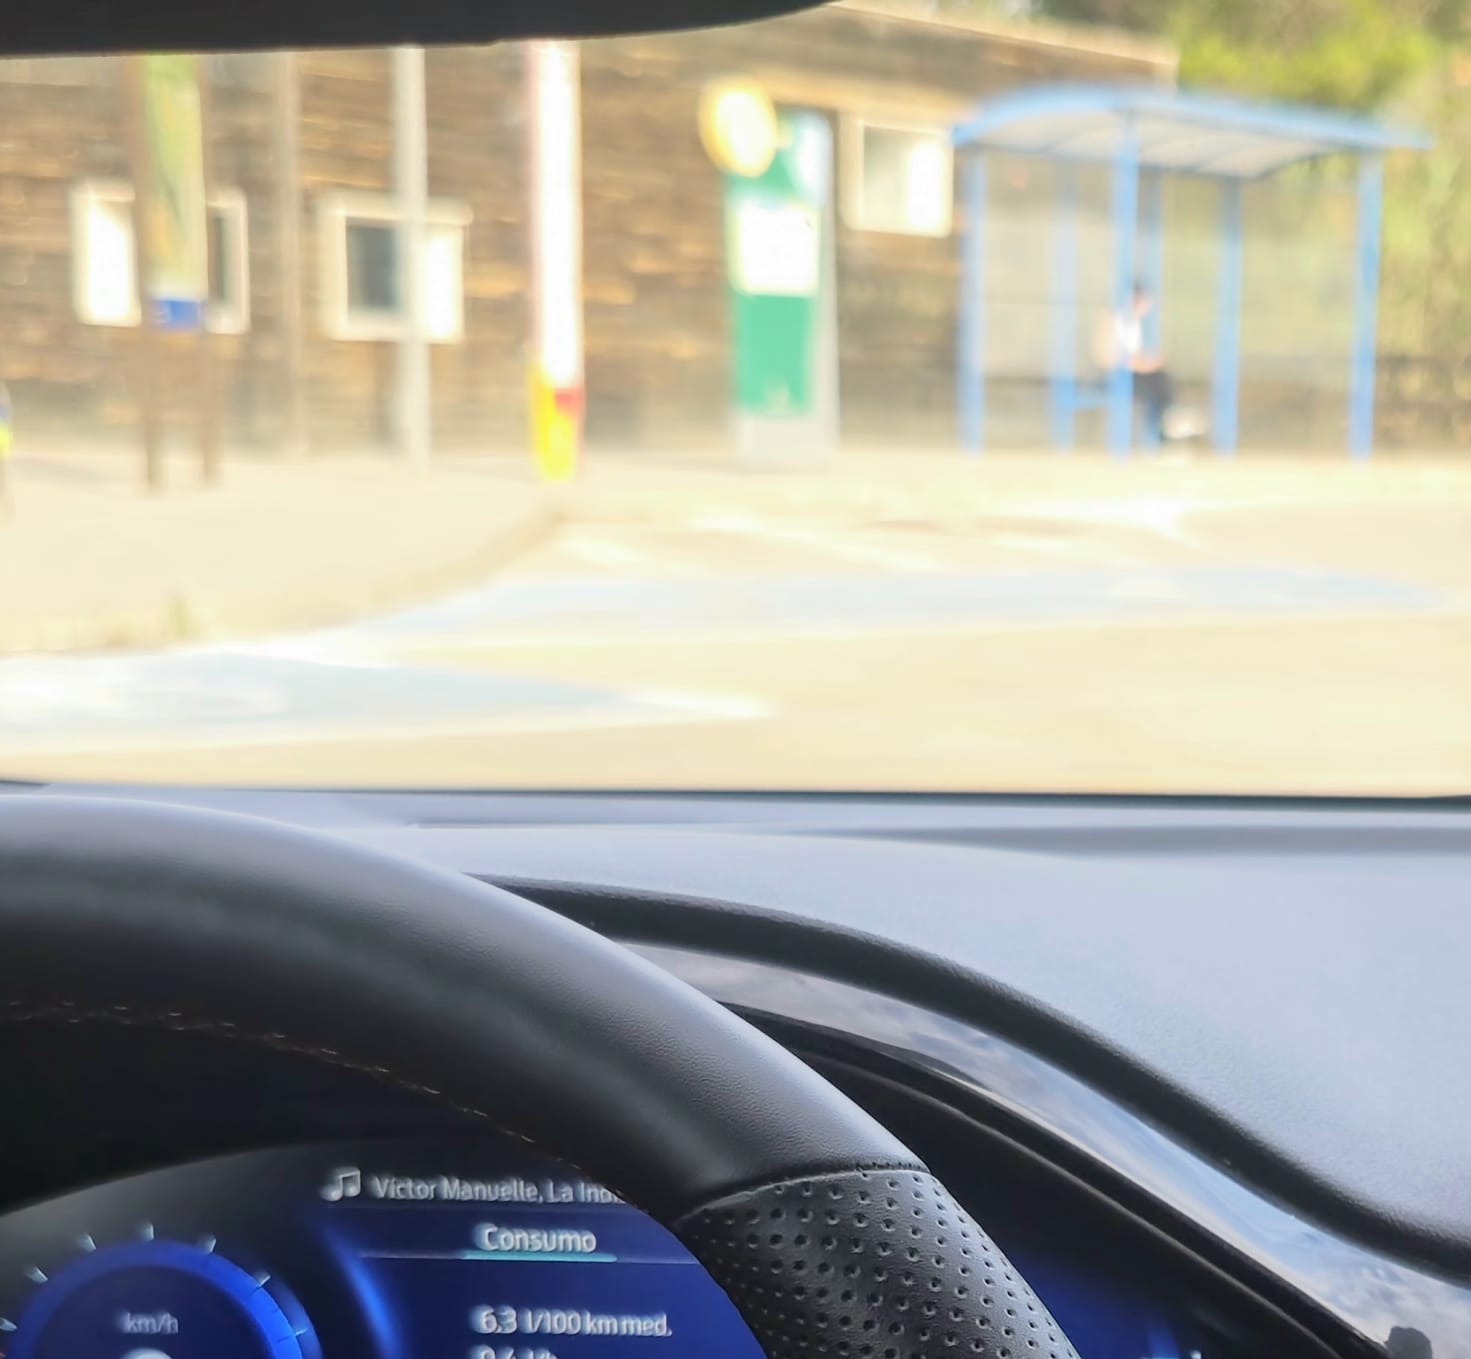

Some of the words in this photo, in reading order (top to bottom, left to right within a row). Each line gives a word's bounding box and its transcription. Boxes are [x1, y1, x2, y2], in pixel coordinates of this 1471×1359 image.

[545, 1179, 574, 1203] La
[475, 1223, 597, 1253] Consumo
[118, 1312, 179, 1334] km/h
[582, 1311, 618, 1335] km
